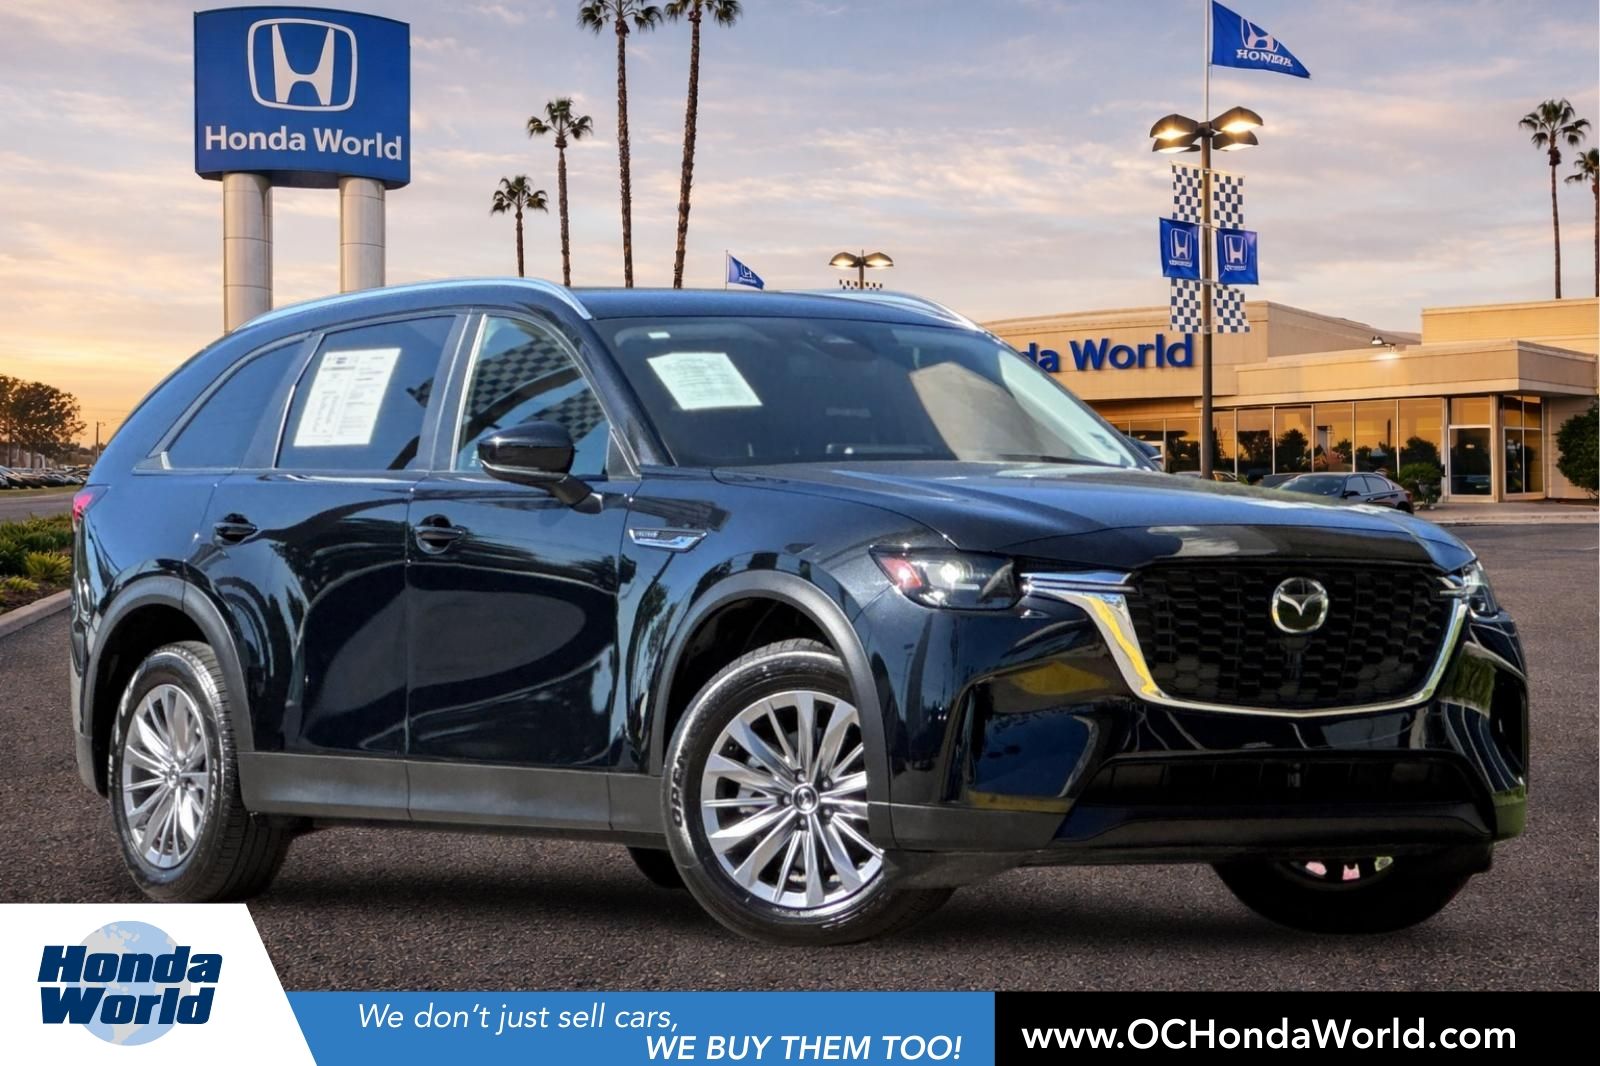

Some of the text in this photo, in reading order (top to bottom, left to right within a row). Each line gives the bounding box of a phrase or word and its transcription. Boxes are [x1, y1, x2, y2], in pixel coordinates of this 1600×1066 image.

[205, 125, 402, 161] Honda World
[1069, 333, 1194, 371] World
